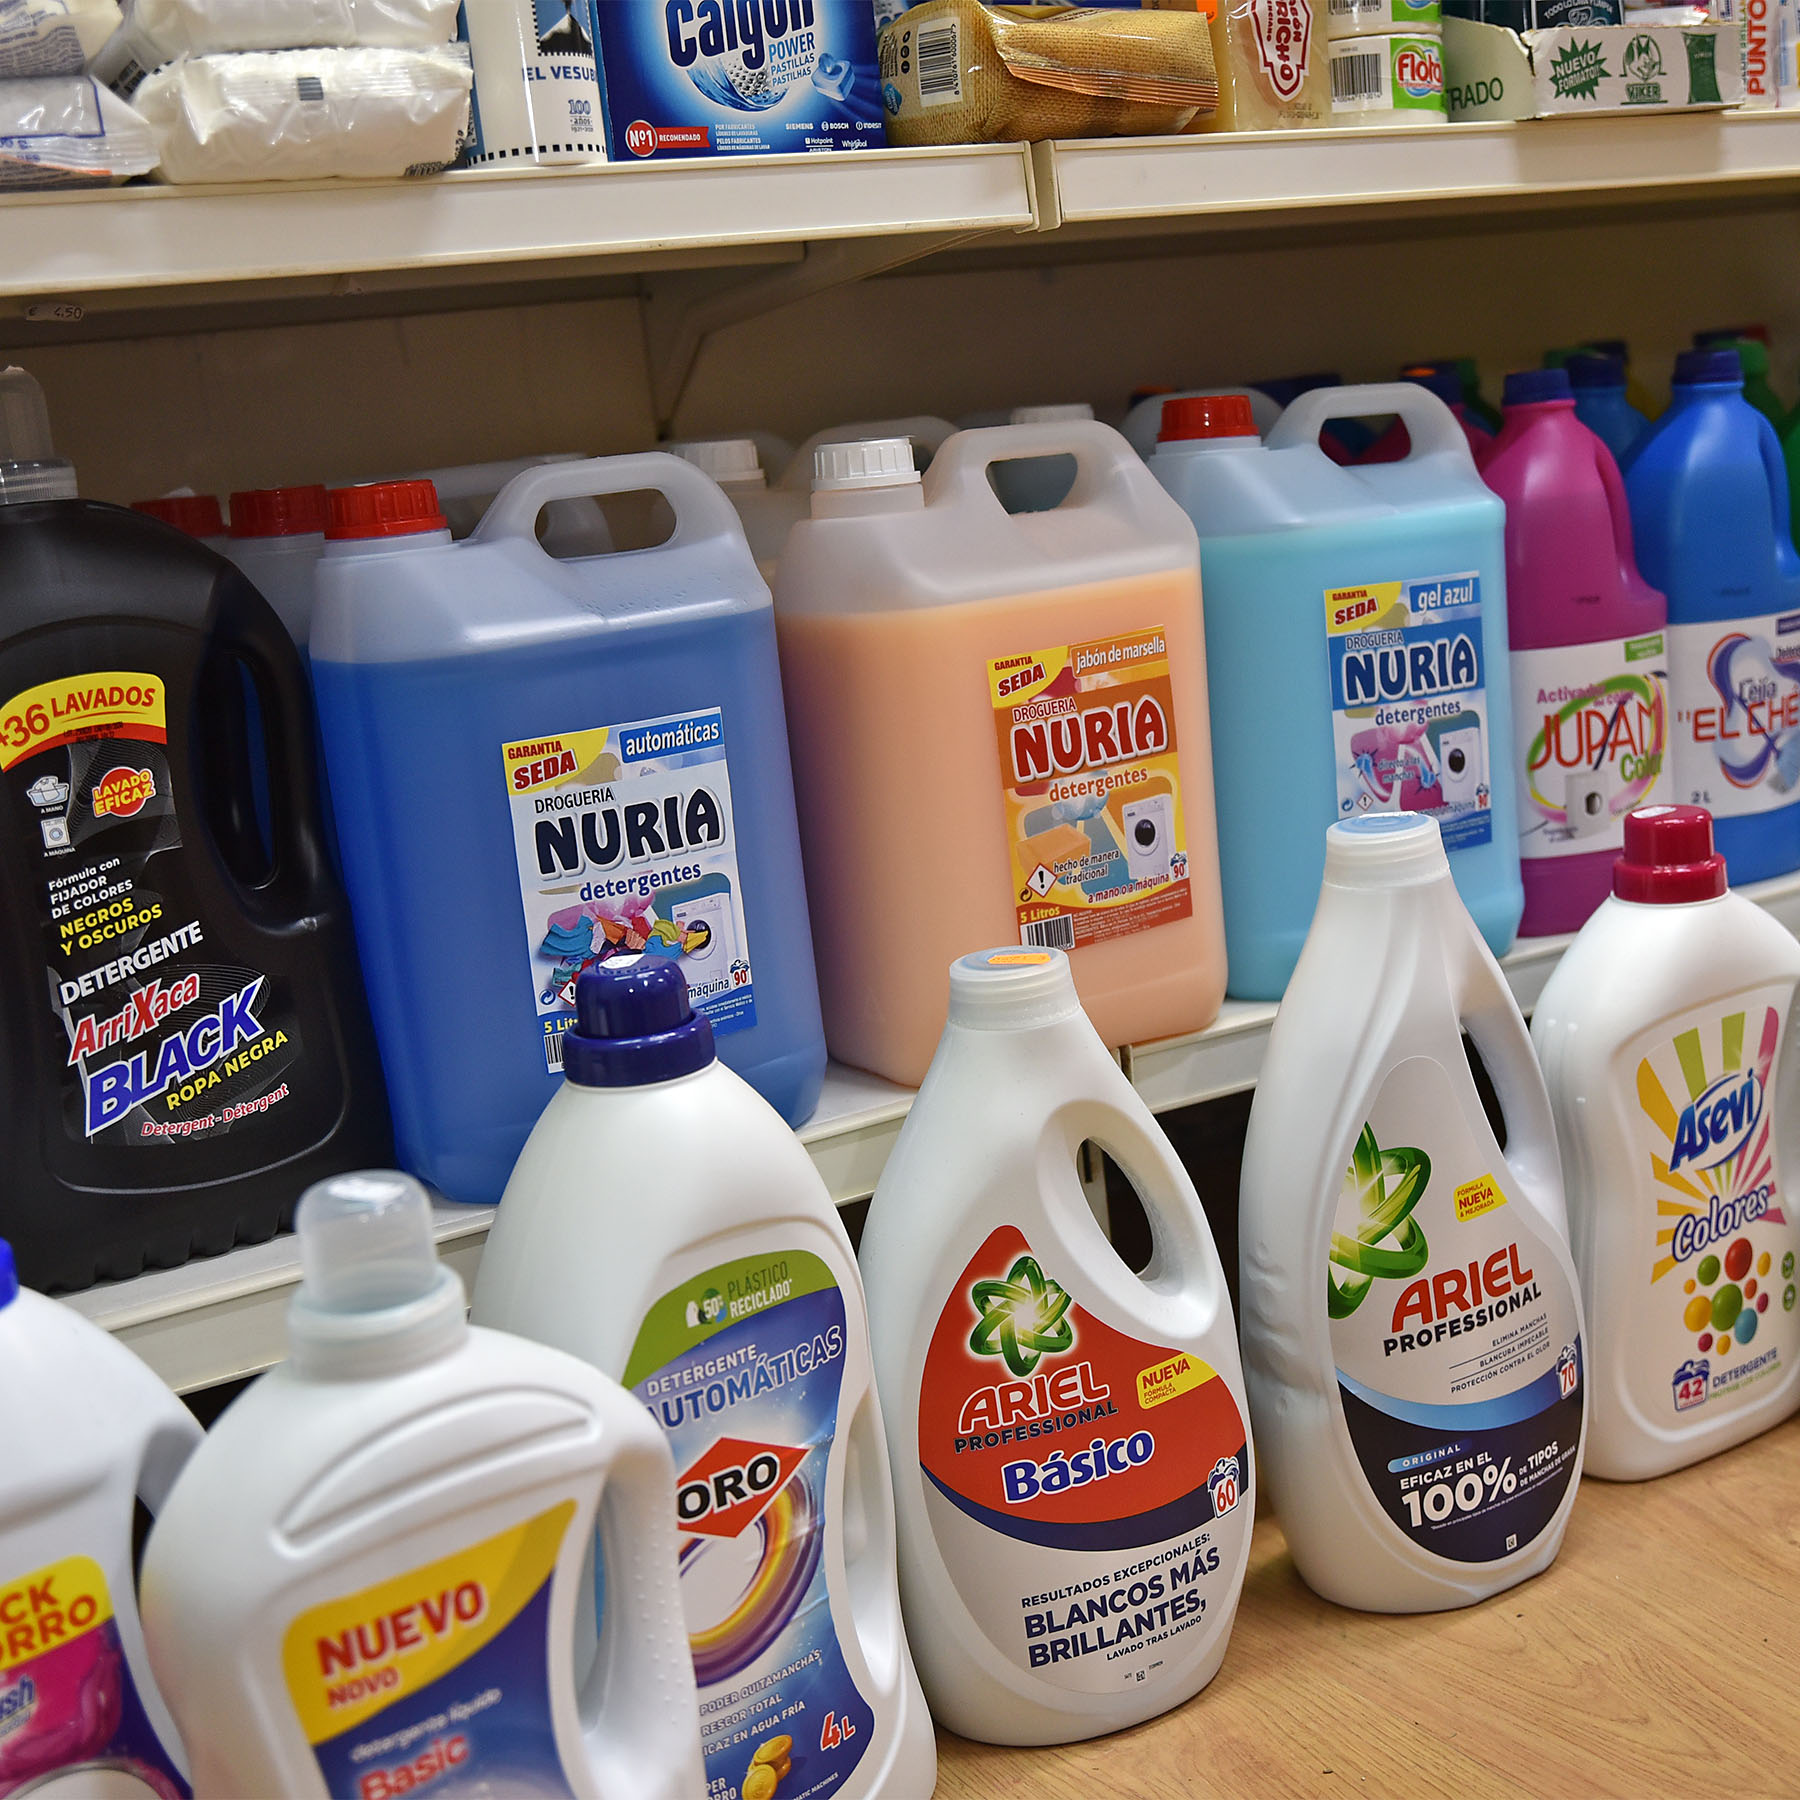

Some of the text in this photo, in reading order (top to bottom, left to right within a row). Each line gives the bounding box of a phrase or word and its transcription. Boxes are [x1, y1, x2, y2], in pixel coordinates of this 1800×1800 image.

[768, 32, 815, 63] POWER
[770, 52, 815, 75] PASTILLAS
[1556, 51, 1596, 78] NUEVO
[522, 66, 547, 81] EL
[772, 68, 812, 87] PASTILHAS
[1448, 78, 1504, 111] RADO
[1627, 85, 1659, 99] VIKER
[629, 130, 654, 149] Nº1
[658, 133, 701, 142] RECOMENDADO
[1335, 598, 1377, 625] SEDA
[1418, 580, 1473, 609] gel azul
[1076, 636, 1165, 674] jabón de marsella
[1346, 632, 1404, 650] DROGUERIA
[994, 656, 1033, 671] GARANTIA
[998, 663, 1046, 697] SEDA
[1344, 637, 1476, 701] NURIA
[51, 686, 156, 719] LAVADOS
[1013, 697, 1077, 722] DROGUERIA
[1375, 701, 1461, 726] detergentes
[507, 740, 562, 760] GARANTIA
[626, 721, 720, 756] automáticas
[1012, 697, 1166, 780] NURIA
[93, 771, 150, 800] LAVADO
[513, 751, 577, 790] SEDA
[1050, 768, 1148, 802] detergentes
[48, 805, 64, 813] MANO
[94, 783, 154, 816] EFICAZ
[534, 787, 615, 813] DROGUERIA
[534, 788, 722, 876] NURIA
[49, 857, 120, 891] Fórmula con
[1054, 850, 1119, 873] hecho de manera
[1066, 865, 1109, 885] tradicional
[1173, 863, 1185, 878] 90
[50, 875, 107, 905] FIJADOR
[52, 879, 133, 919] DE COLORES
[580, 864, 701, 901] detergentes
[1088, 873, 1170, 903] a mano o a máquina
[60, 897, 134, 939] NEGROS
[61, 904, 163, 956] Y OSCUROS
[1020, 906, 1060, 922] 5 Litros
[60, 920, 203, 1005] DETERGENTE
[687, 969, 747, 998] máquina 90
[67, 973, 200, 1066] ArriXaca
[543, 1021, 553, 1033] 5
[85, 975, 265, 1137] BLACK
[166, 1030, 288, 1111] ROPA NEGRA
[141, 1114, 214, 1138] Detergent
[1669, 1068, 1755, 1172] Asevi
[1459, 1187, 1493, 1209] NUEVA
[1465, 1199, 1494, 1216] MEJORADA
[1672, 1186, 1769, 1262] Colores
[727, 1261, 789, 1299] PLÁSTICO
[1392, 1243, 1533, 1334] ARIEL
[1383, 1282, 1542, 1357] PROFESSIONAL
[1492, 1313, 1547, 1347] ELIMINA MANCHAS
[1480, 1327, 1549, 1368] BLANCURA IMPECABLE
[647, 1344, 758, 1396] DETERGENTE
[1142, 1358, 1191, 1390] NUEVA
[1451, 1341, 1550, 1394] PROTECCIÓN CONTRA EL OLOR
[1561, 1362, 1575, 1393] 70
[958, 1361, 1111, 1435] ARIEL
[1144, 1387, 1177, 1405] COMPACTA
[1679, 1378, 1703, 1399] 42
[954, 1400, 1118, 1454] PROFESSIONAL
[1002, 1430, 1155, 1503] Básico
[1400, 1451, 1493, 1490] EFICAZ EN EL
[1402, 1444, 1461, 1467] ORIGINAL
[677, 1455, 778, 1520] ORO
[1402, 1456, 1517, 1528] 100%
[1519, 1466, 1528, 1476] DE
[1527, 1441, 1559, 1470] TIPOS
[1519, 1477, 1529, 1487] DE
[1529, 1463, 1555, 1484] MANCHAS
[1216, 1479, 1236, 1512] 60
[1022, 1533, 1211, 1609] RESULTADOS EXCEPCIONALES:
[1025, 1547, 1221, 1639] BLANCOS MÁS
[0, 1594, 98, 1661] RRO
[315, 1580, 485, 1678] NUEVO
[1029, 1588, 1207, 1668] BRILLANTES,
[1107, 1615, 1202, 1661] LAVADO TRAS LAVADO
[327, 1665, 400, 1709] NOVO
[700, 1692, 739, 1716] PODER
[702, 1693, 783, 1737] RESCOR TOTAL
[703, 1701, 806, 1757] ICAZ EN AGUA FRÍA
[359, 1735, 470, 1800] Basic
[705, 1777, 727, 1795] PER
